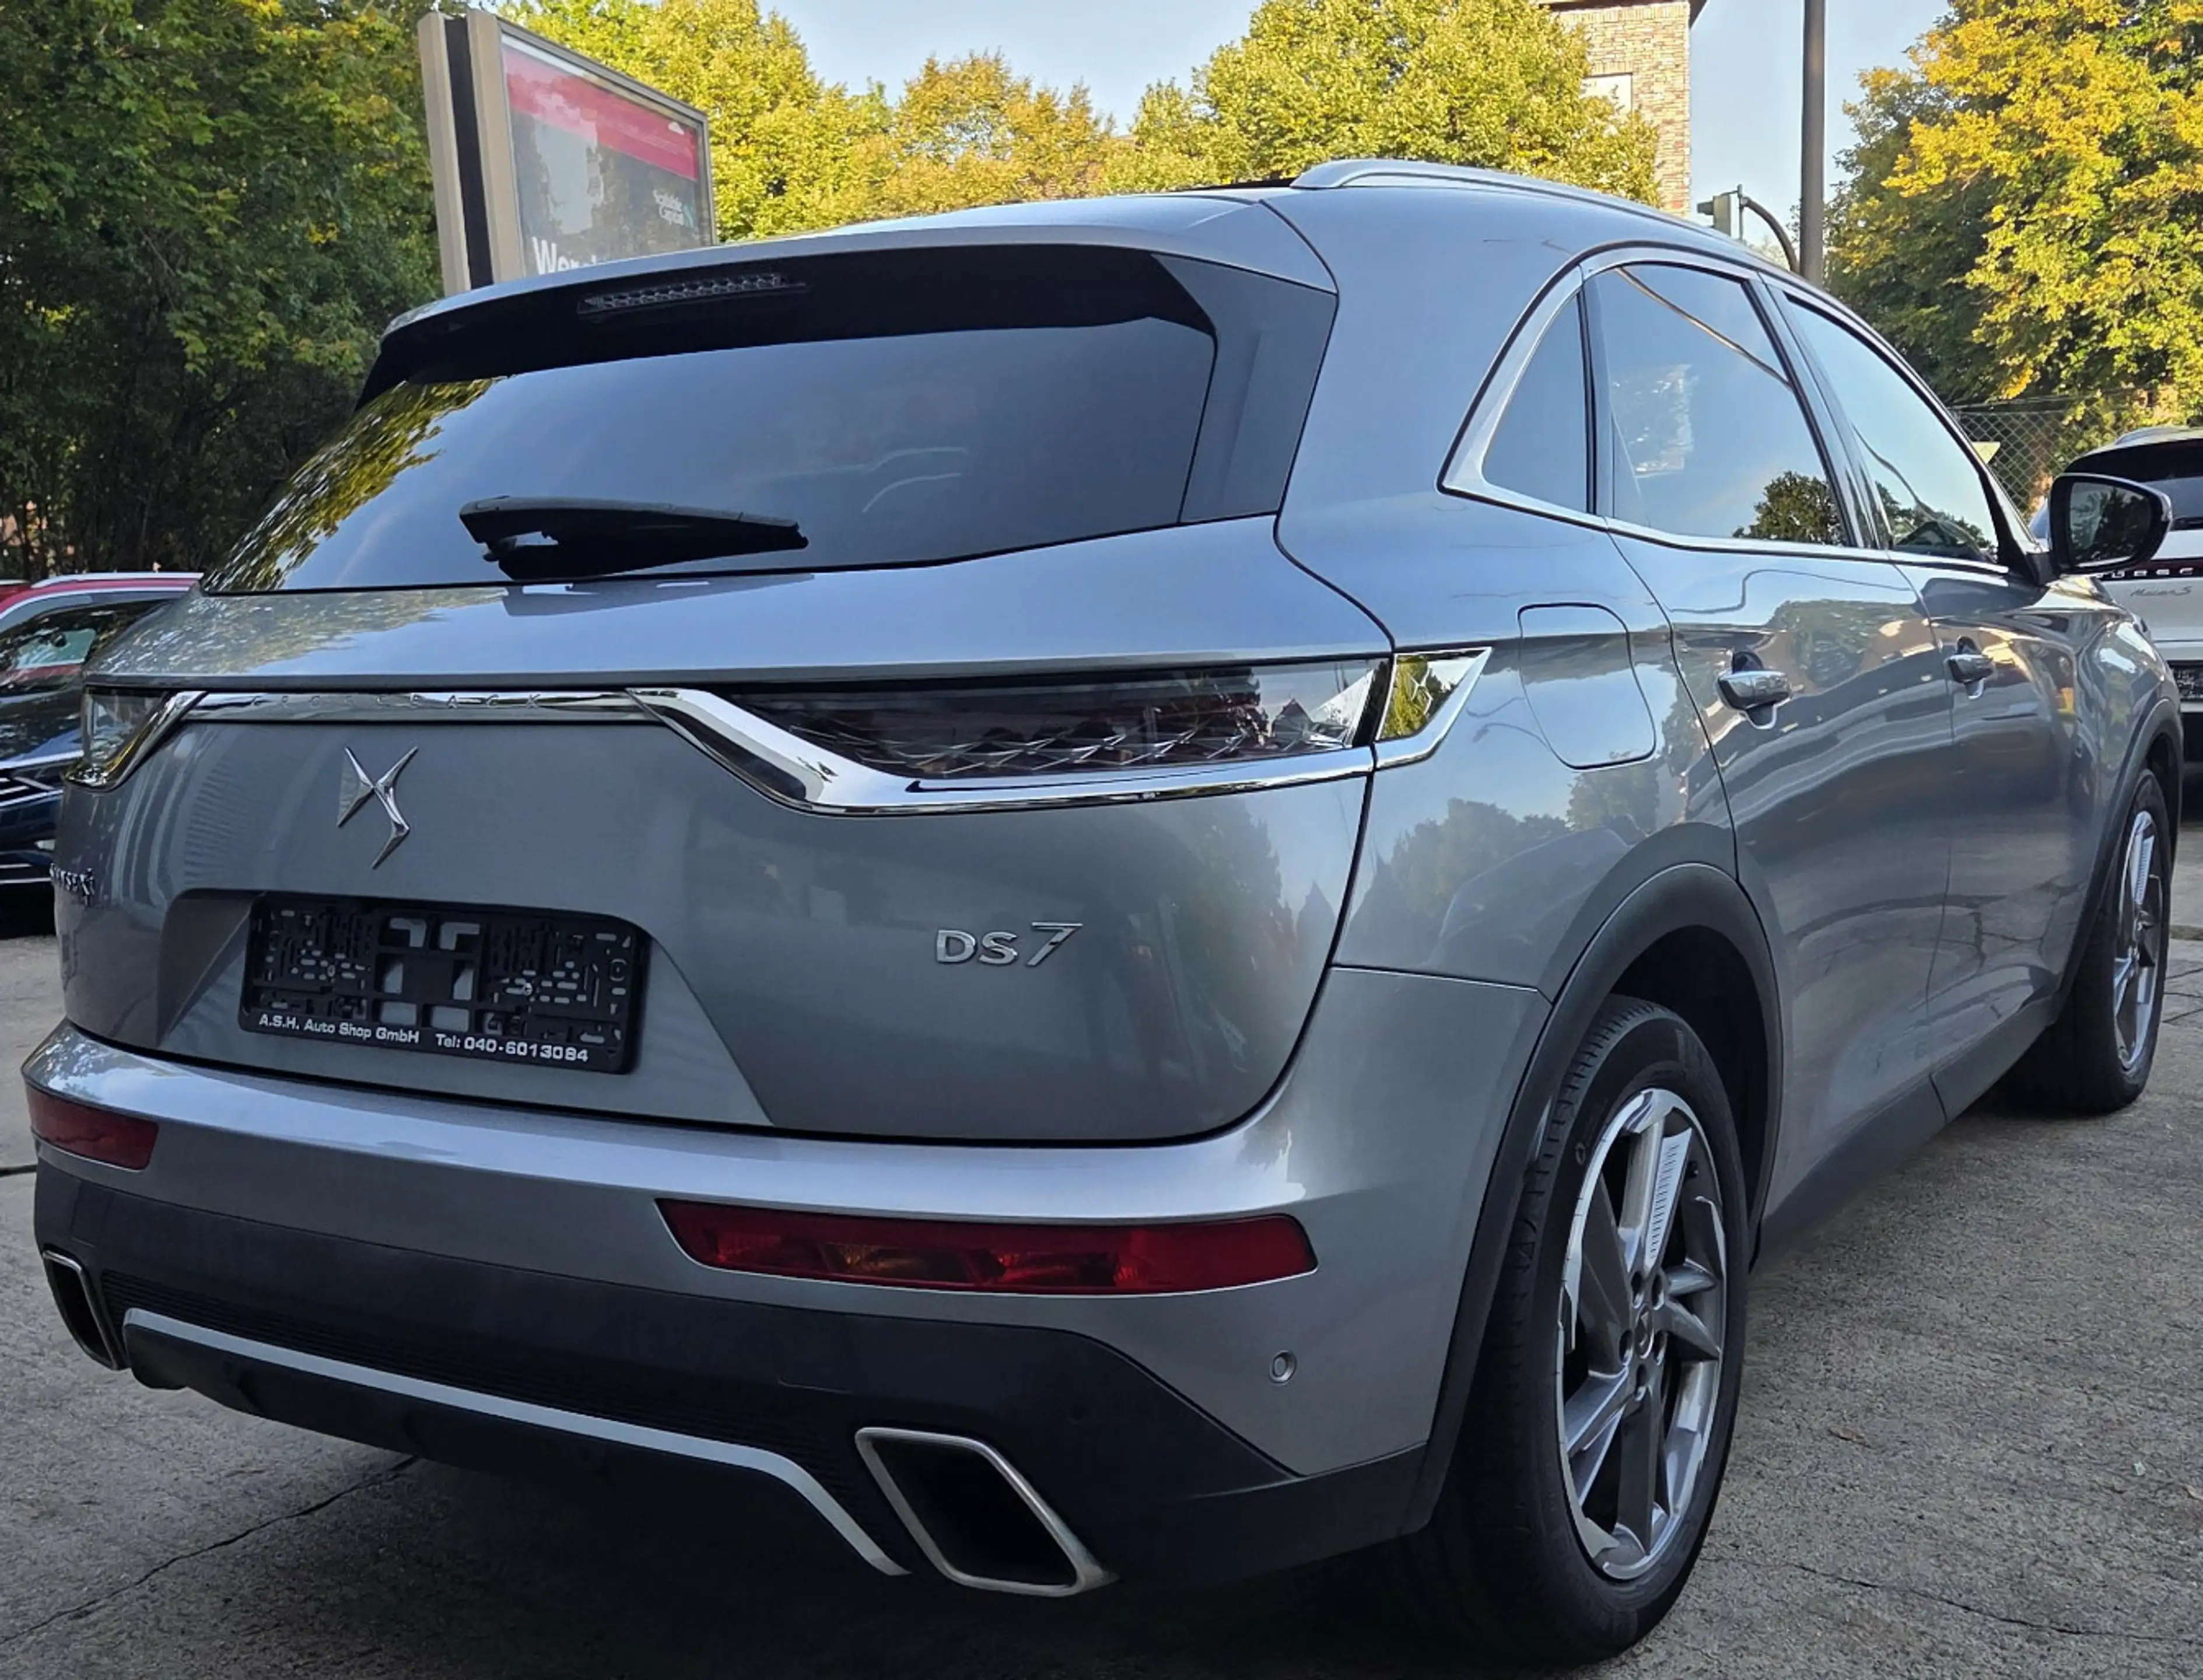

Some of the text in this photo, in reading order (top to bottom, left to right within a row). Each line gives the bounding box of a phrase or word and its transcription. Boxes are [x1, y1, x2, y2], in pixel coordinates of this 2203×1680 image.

[259, 1013, 589, 1062] A.S.H. Auto Shop GmbH Tel: 040-6013084
